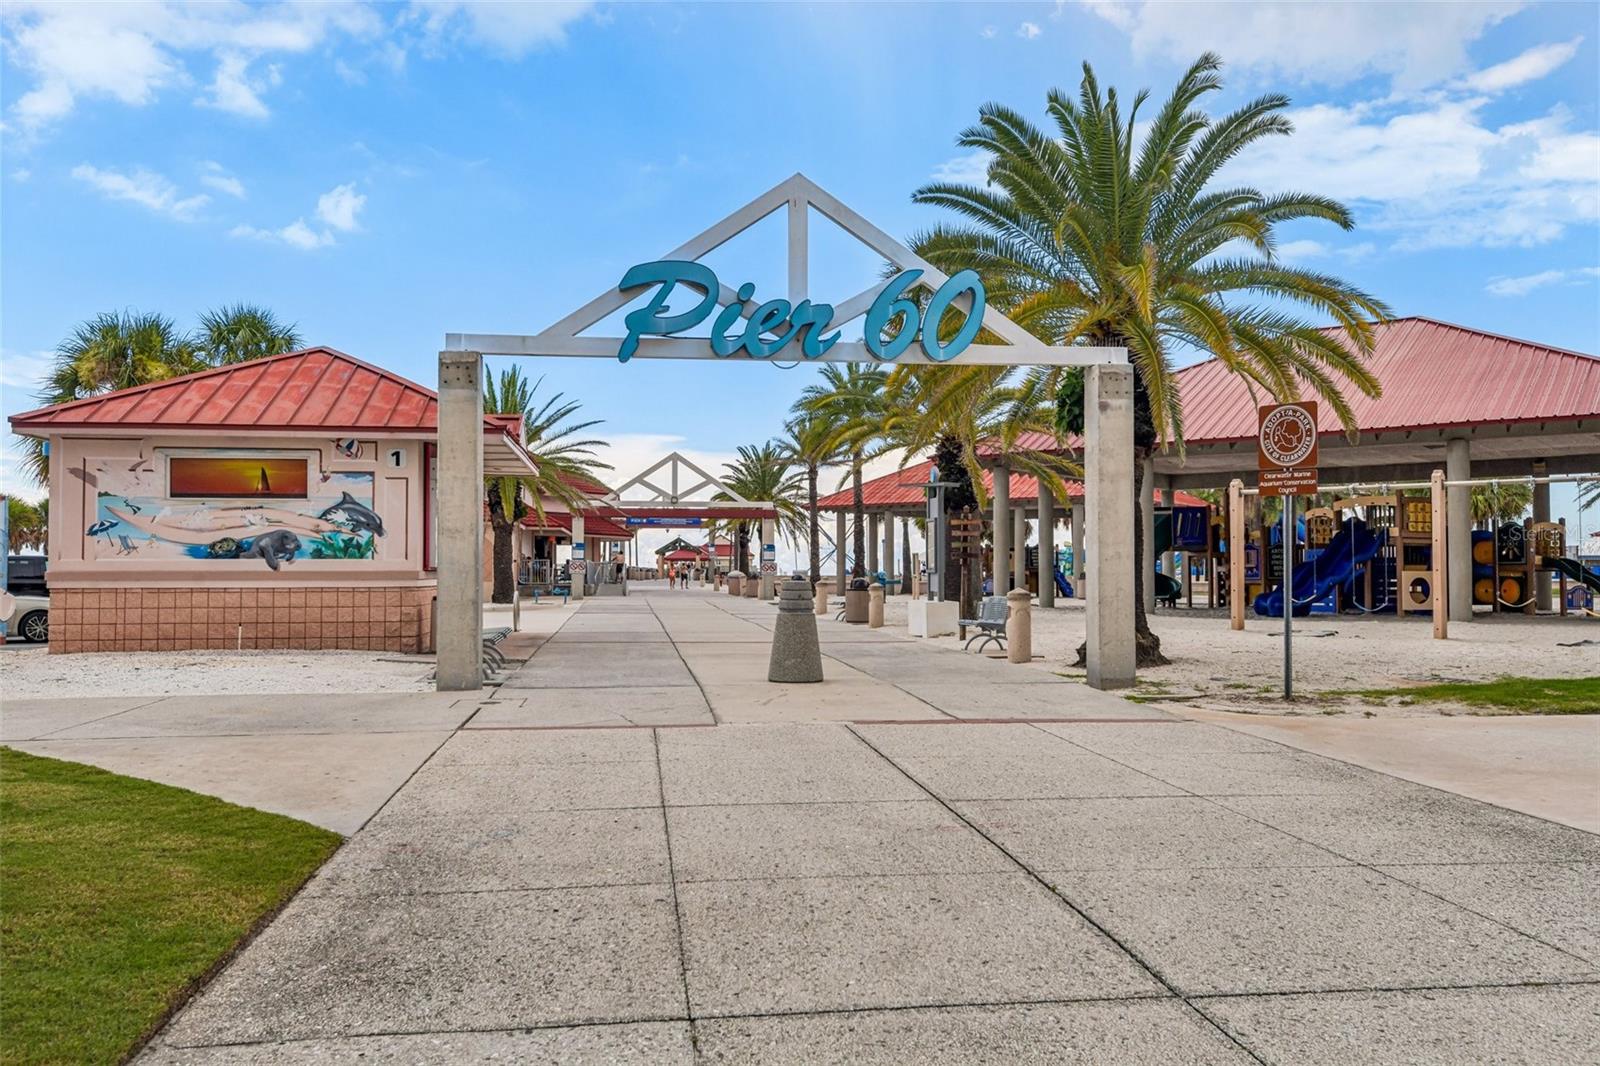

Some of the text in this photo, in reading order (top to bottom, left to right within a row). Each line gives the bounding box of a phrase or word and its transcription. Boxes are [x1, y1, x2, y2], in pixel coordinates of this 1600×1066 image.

[617, 259, 986, 363] Pier 60
[391, 451, 401, 467] 1
[1264, 436, 1311, 462] CITY OF CLEARWATER
